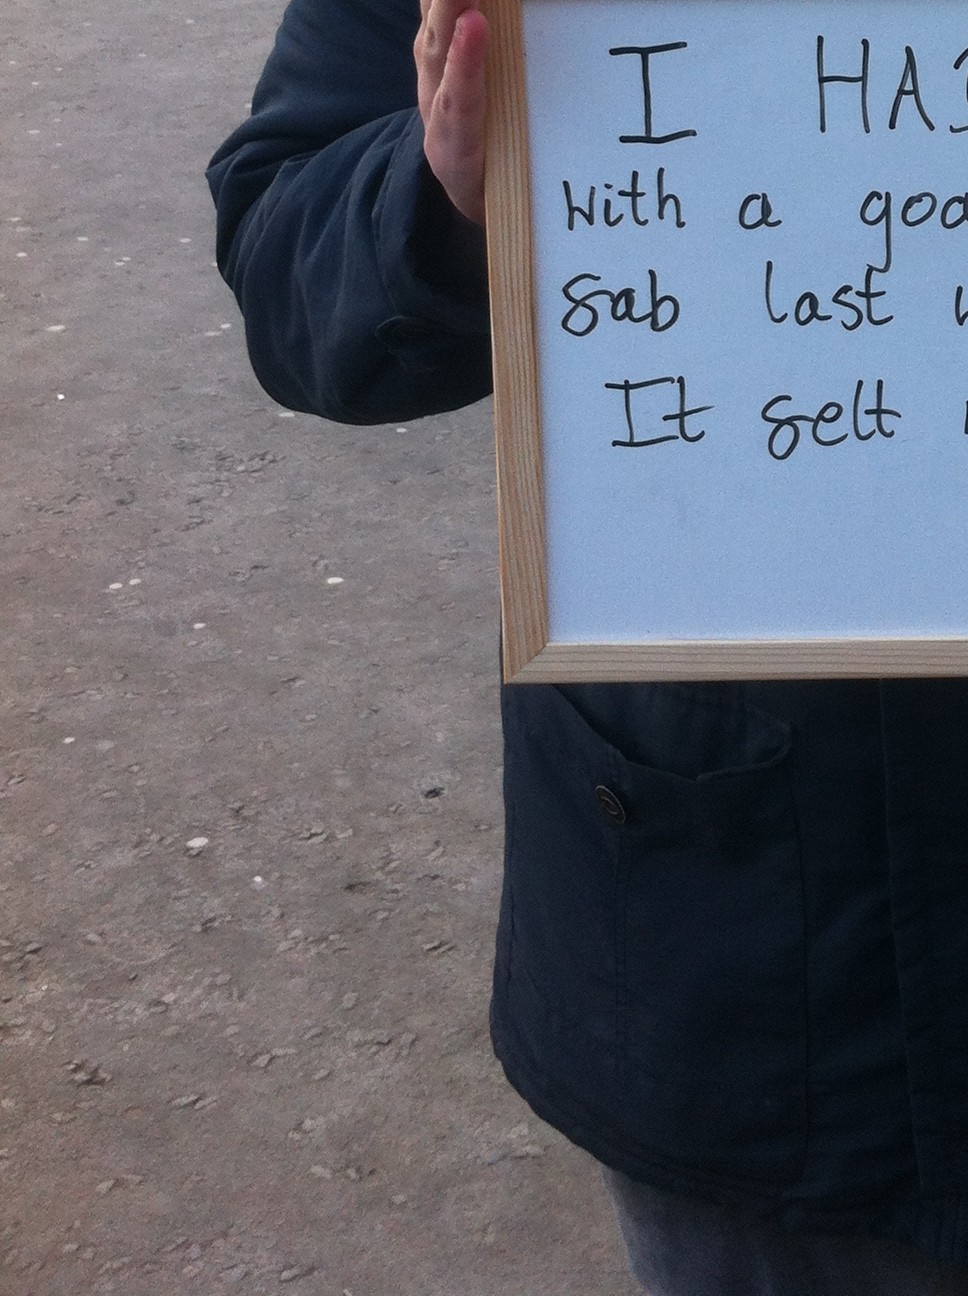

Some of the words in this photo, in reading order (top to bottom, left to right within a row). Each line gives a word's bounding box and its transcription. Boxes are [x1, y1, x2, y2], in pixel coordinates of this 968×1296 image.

[609, 41, 697, 144] I
[738, 192, 782, 229] a
[764, 260, 894, 331] last
[604, 375, 715, 447] It
